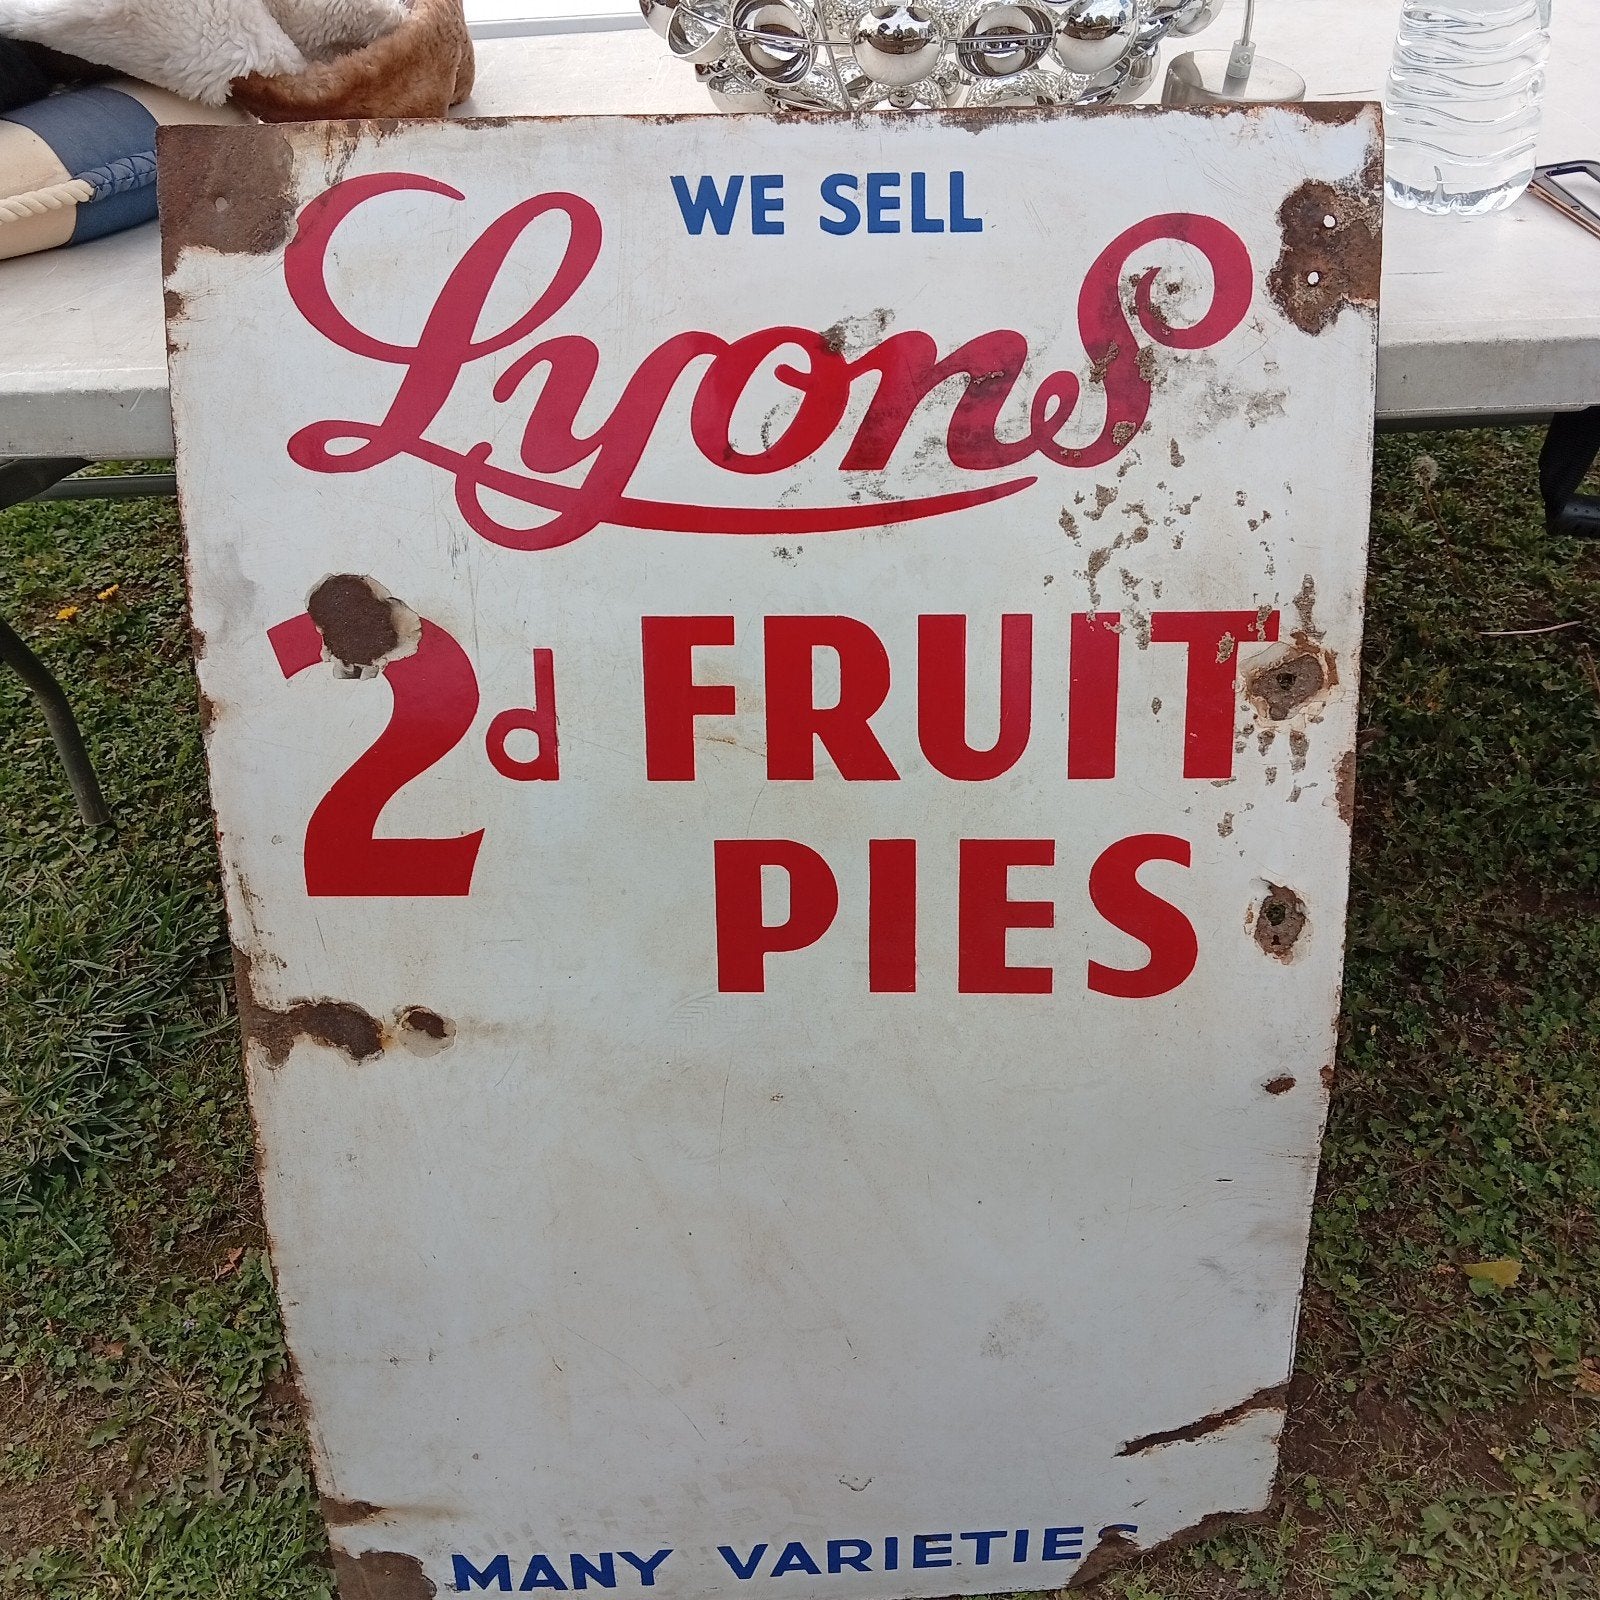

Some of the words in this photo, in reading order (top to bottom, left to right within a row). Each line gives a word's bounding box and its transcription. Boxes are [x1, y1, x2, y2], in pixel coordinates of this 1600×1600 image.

[672, 175, 785, 236] WE
[819, 171, 984, 236] SELL
[285, 172, 1254, 551] Lyons
[267, 604, 560, 897] 2d
[642, 611, 1280, 782] FRUIT
[714, 834, 1198, 999] PIES
[452, 1550, 670, 1592] MANY
